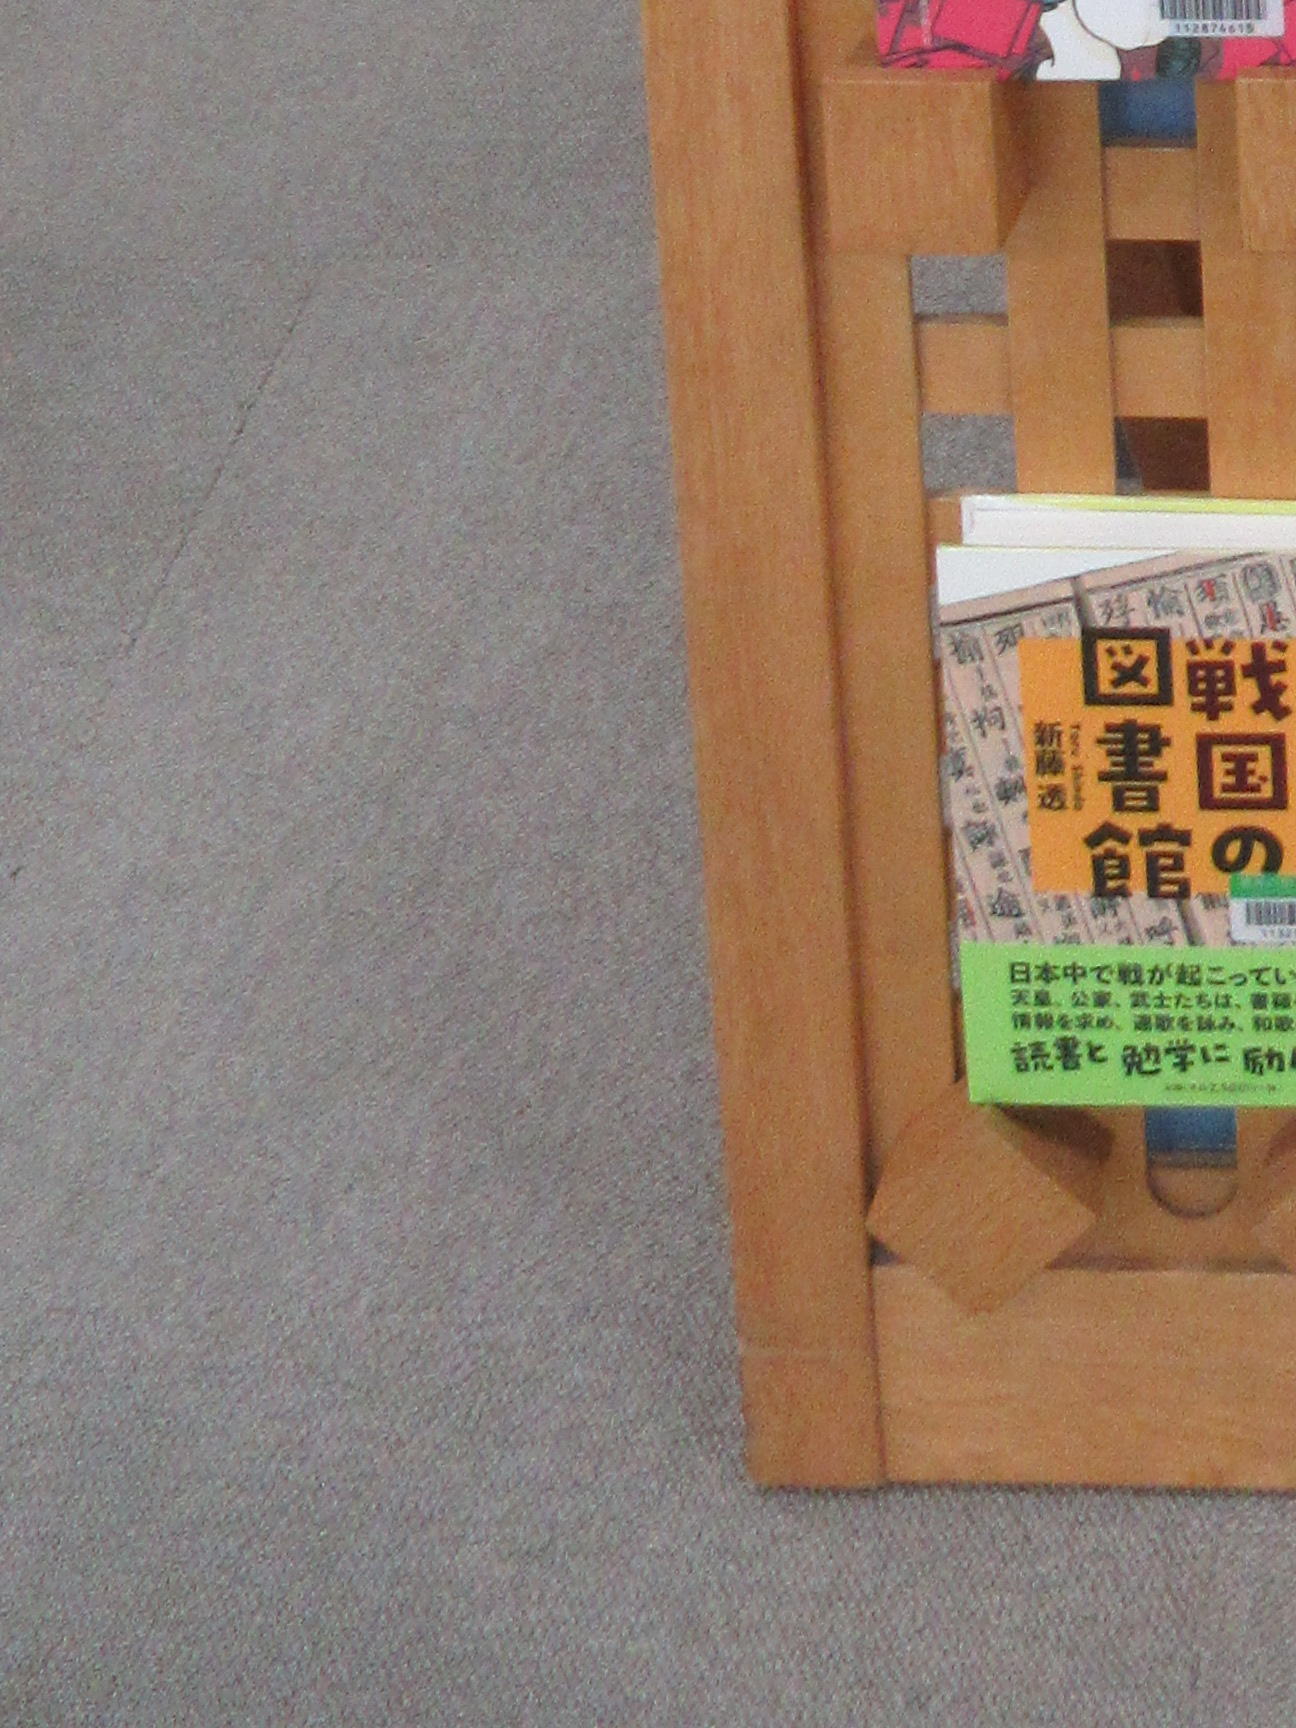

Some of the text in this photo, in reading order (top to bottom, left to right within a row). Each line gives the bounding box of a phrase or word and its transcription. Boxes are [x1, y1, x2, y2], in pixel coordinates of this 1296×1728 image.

[1082, 627, 1193, 899] 図書館
[1185, 638, 1290, 875] 戦国の
